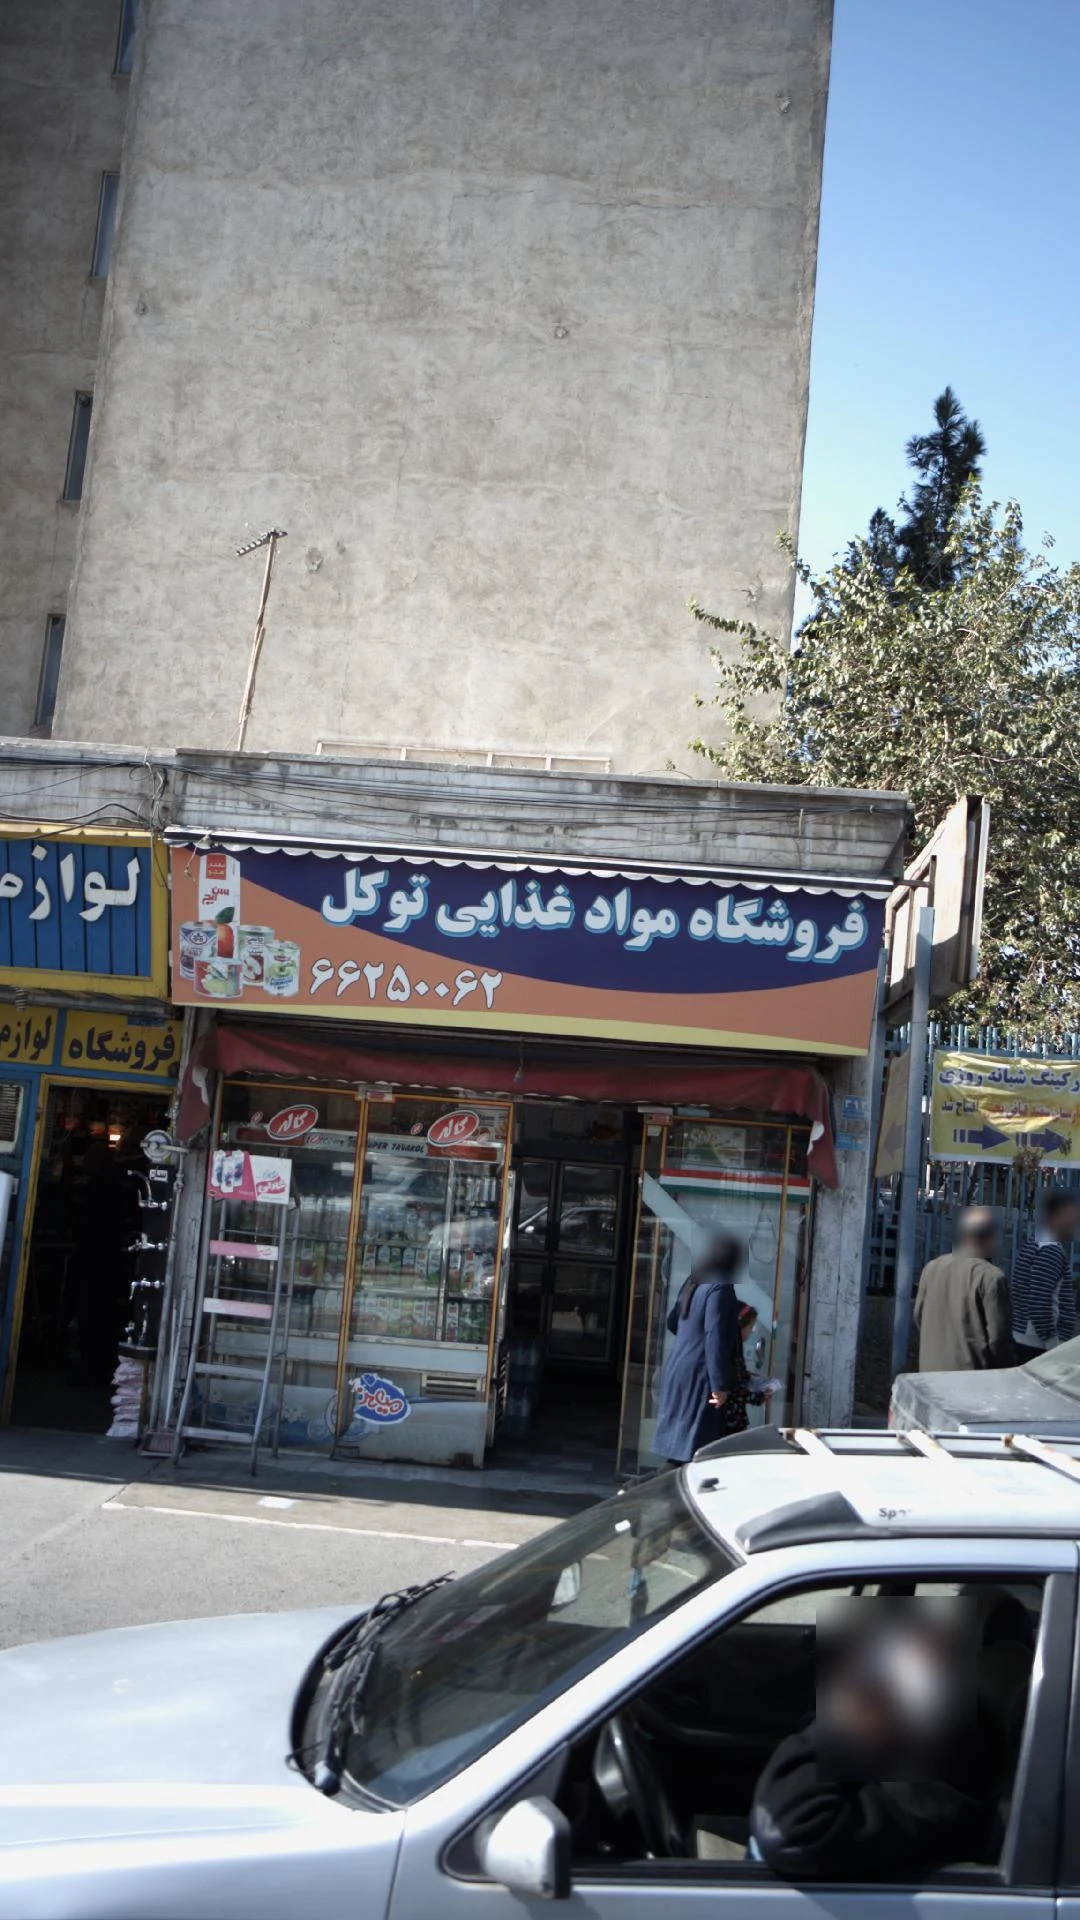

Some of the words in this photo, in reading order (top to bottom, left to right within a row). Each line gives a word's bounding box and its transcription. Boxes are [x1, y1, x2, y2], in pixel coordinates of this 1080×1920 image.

[321, 866, 430, 933] توکل
[435, 878, 575, 938] غذایی
[583, 886, 680, 952] مواد
[687, 893, 868, 964] فروشگاه
[309, 958, 503, 1009] ۶۶۲۵۰۰۶۲
[68, 1025, 175, 1072] فروشگاه
[939, 1069, 983, 1087] روزی
[988, 1068, 1027, 1088] شبانه
